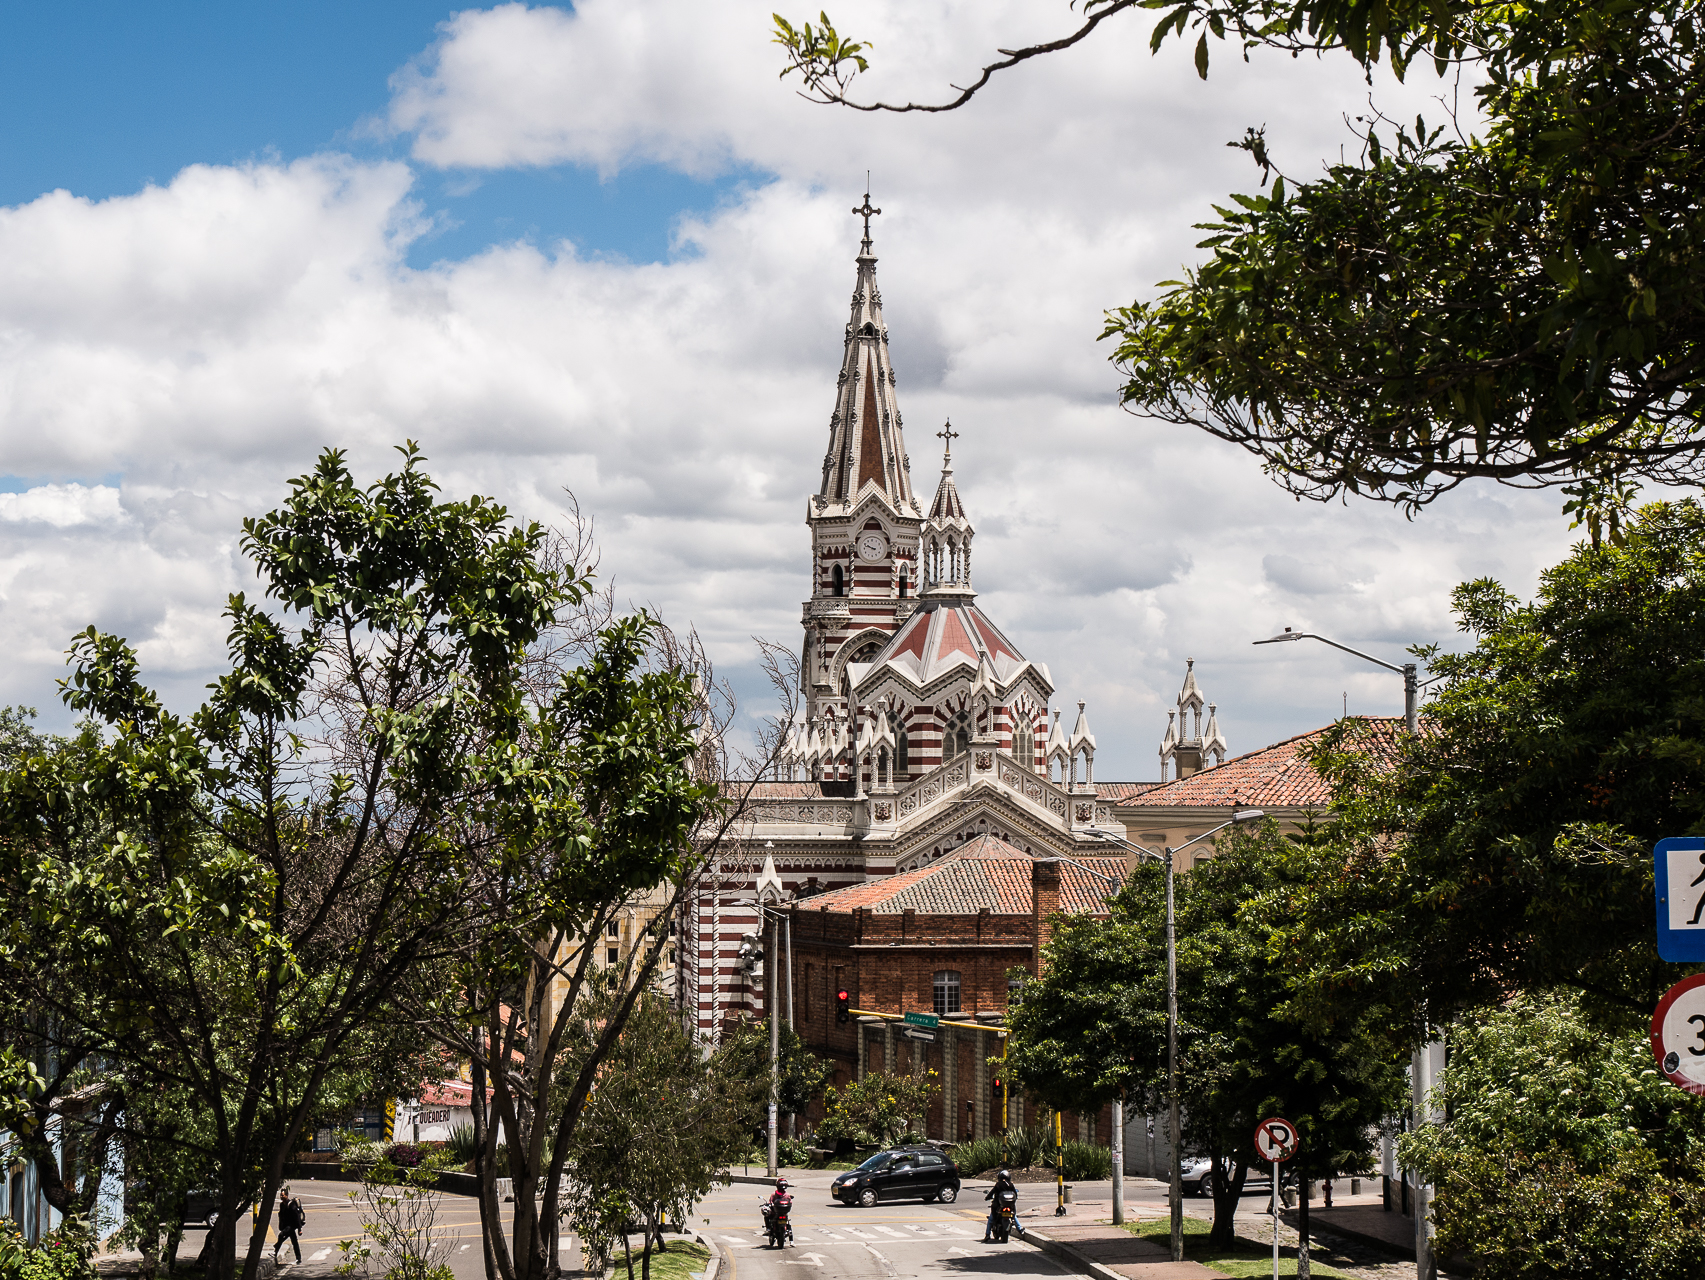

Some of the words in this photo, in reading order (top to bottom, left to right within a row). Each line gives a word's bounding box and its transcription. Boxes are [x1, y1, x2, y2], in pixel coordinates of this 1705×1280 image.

[907, 1014, 928, 1024] Carrera
[1686, 1014, 1705, 1056] 3
[1268, 1125, 1290, 1150] P
